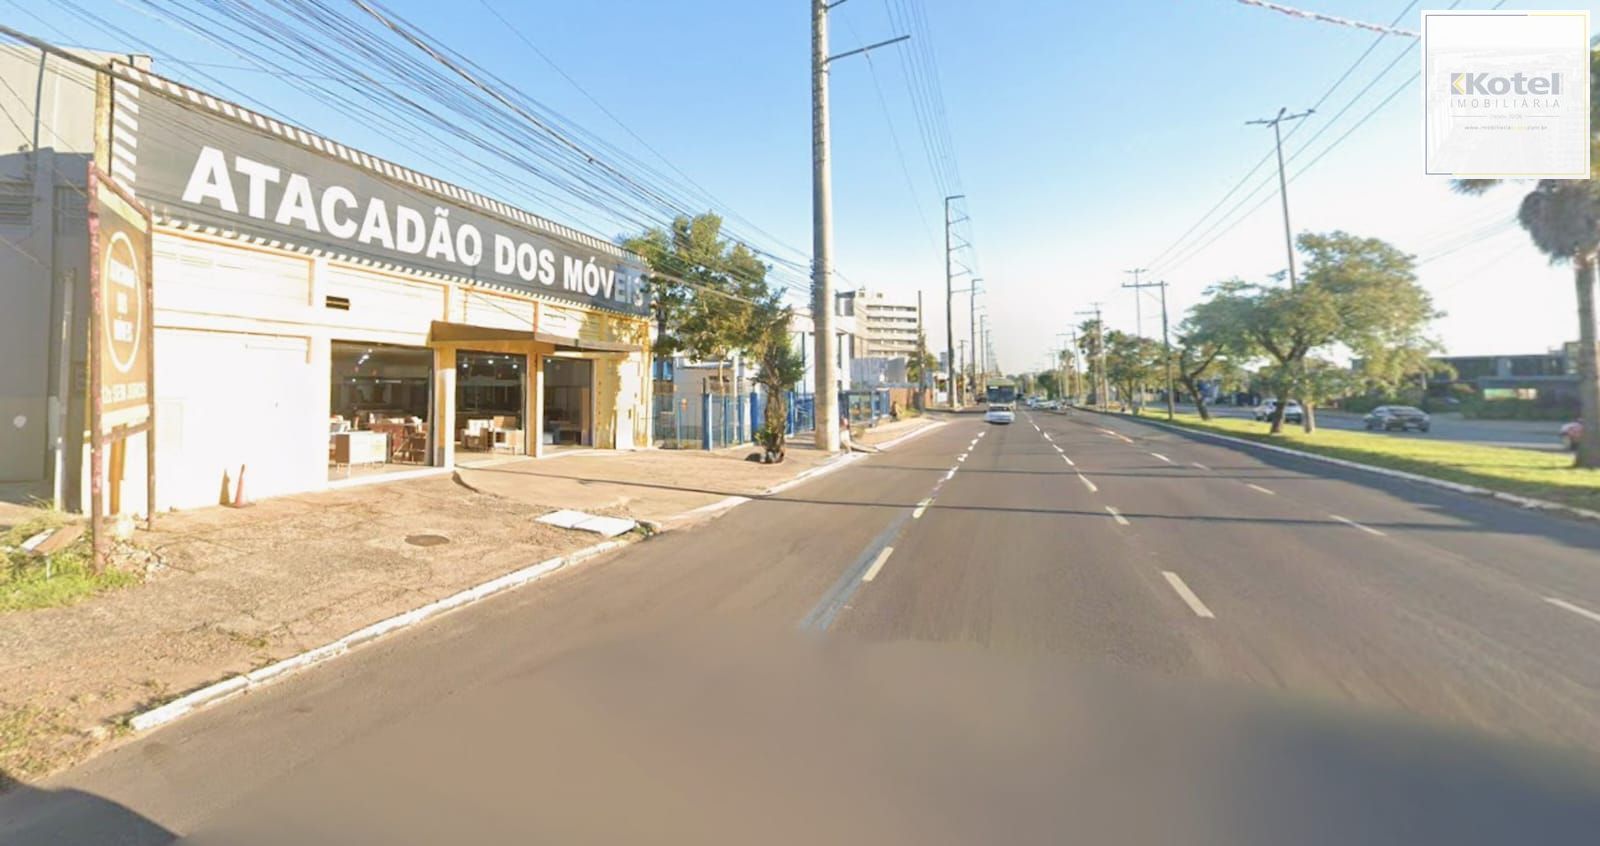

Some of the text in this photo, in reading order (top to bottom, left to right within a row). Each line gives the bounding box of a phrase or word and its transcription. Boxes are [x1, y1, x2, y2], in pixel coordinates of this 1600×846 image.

[182, 145, 645, 307] ATACADÃO DOS MÓVEIS
